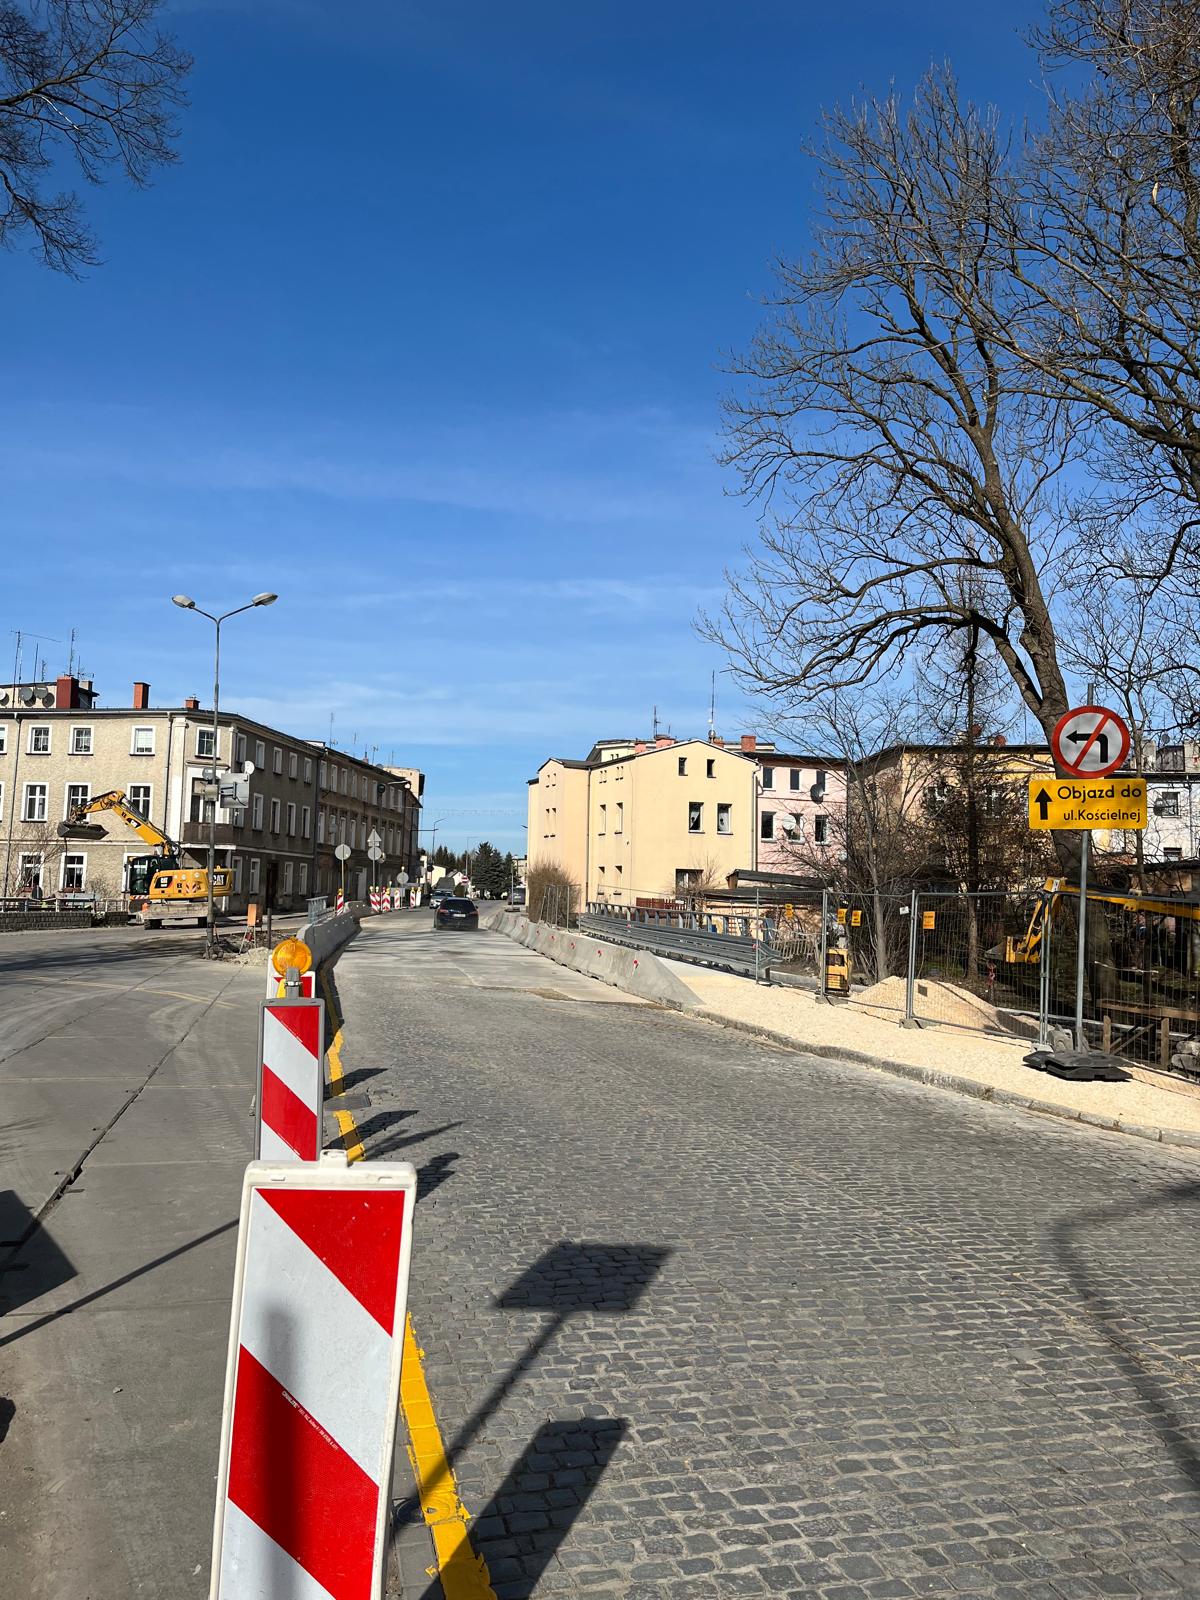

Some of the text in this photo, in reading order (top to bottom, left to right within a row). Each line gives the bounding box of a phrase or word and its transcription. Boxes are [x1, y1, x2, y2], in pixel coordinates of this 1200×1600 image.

[1058, 784, 1142, 803] Objazd do
[1063, 809, 1141, 822] ul.Kościelnej
